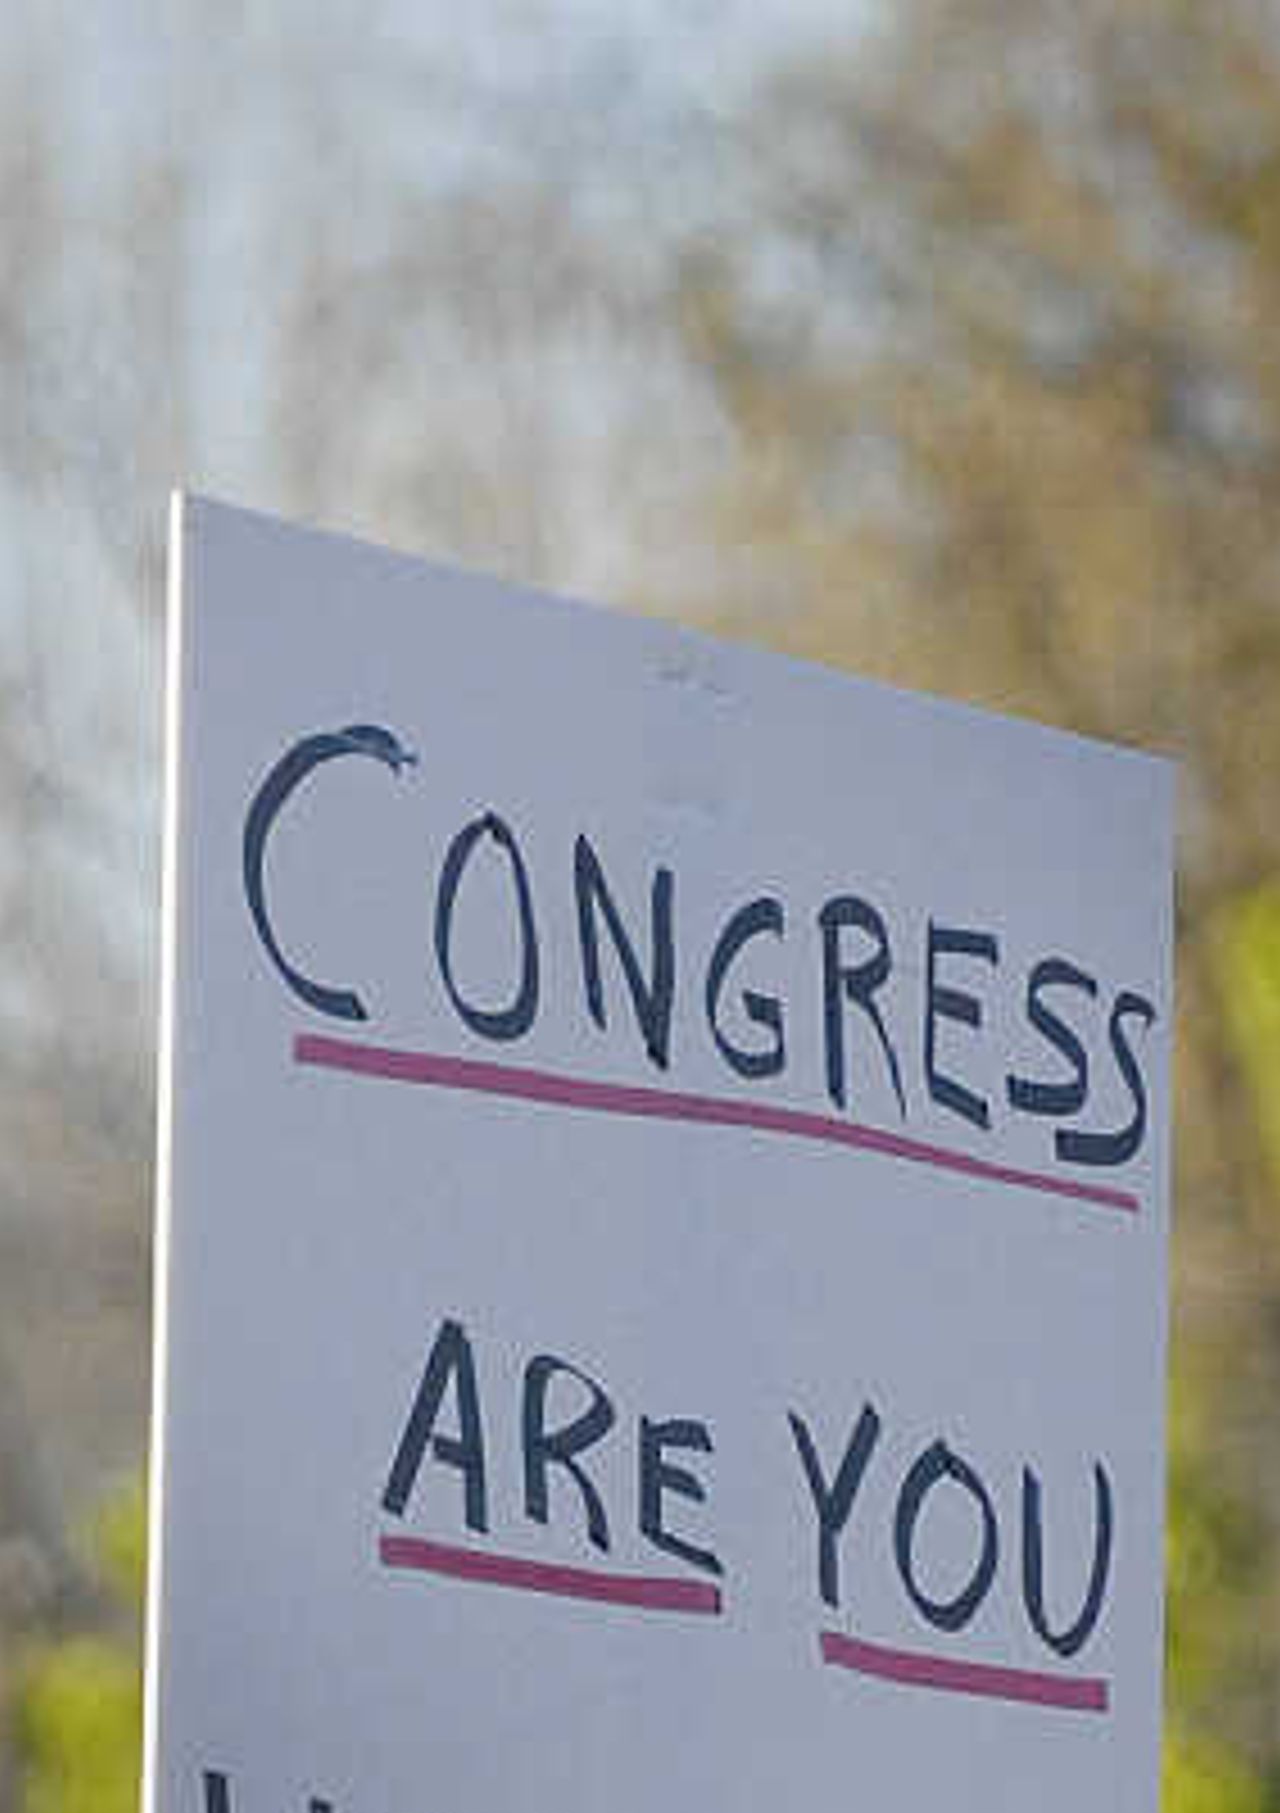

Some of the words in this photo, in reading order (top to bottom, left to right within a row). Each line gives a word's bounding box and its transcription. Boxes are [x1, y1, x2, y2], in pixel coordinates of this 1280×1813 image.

[242, 723, 1158, 1168] CONGRESS
[380, 1317, 724, 1577] ARE
[787, 1402, 1114, 1660] YOU
